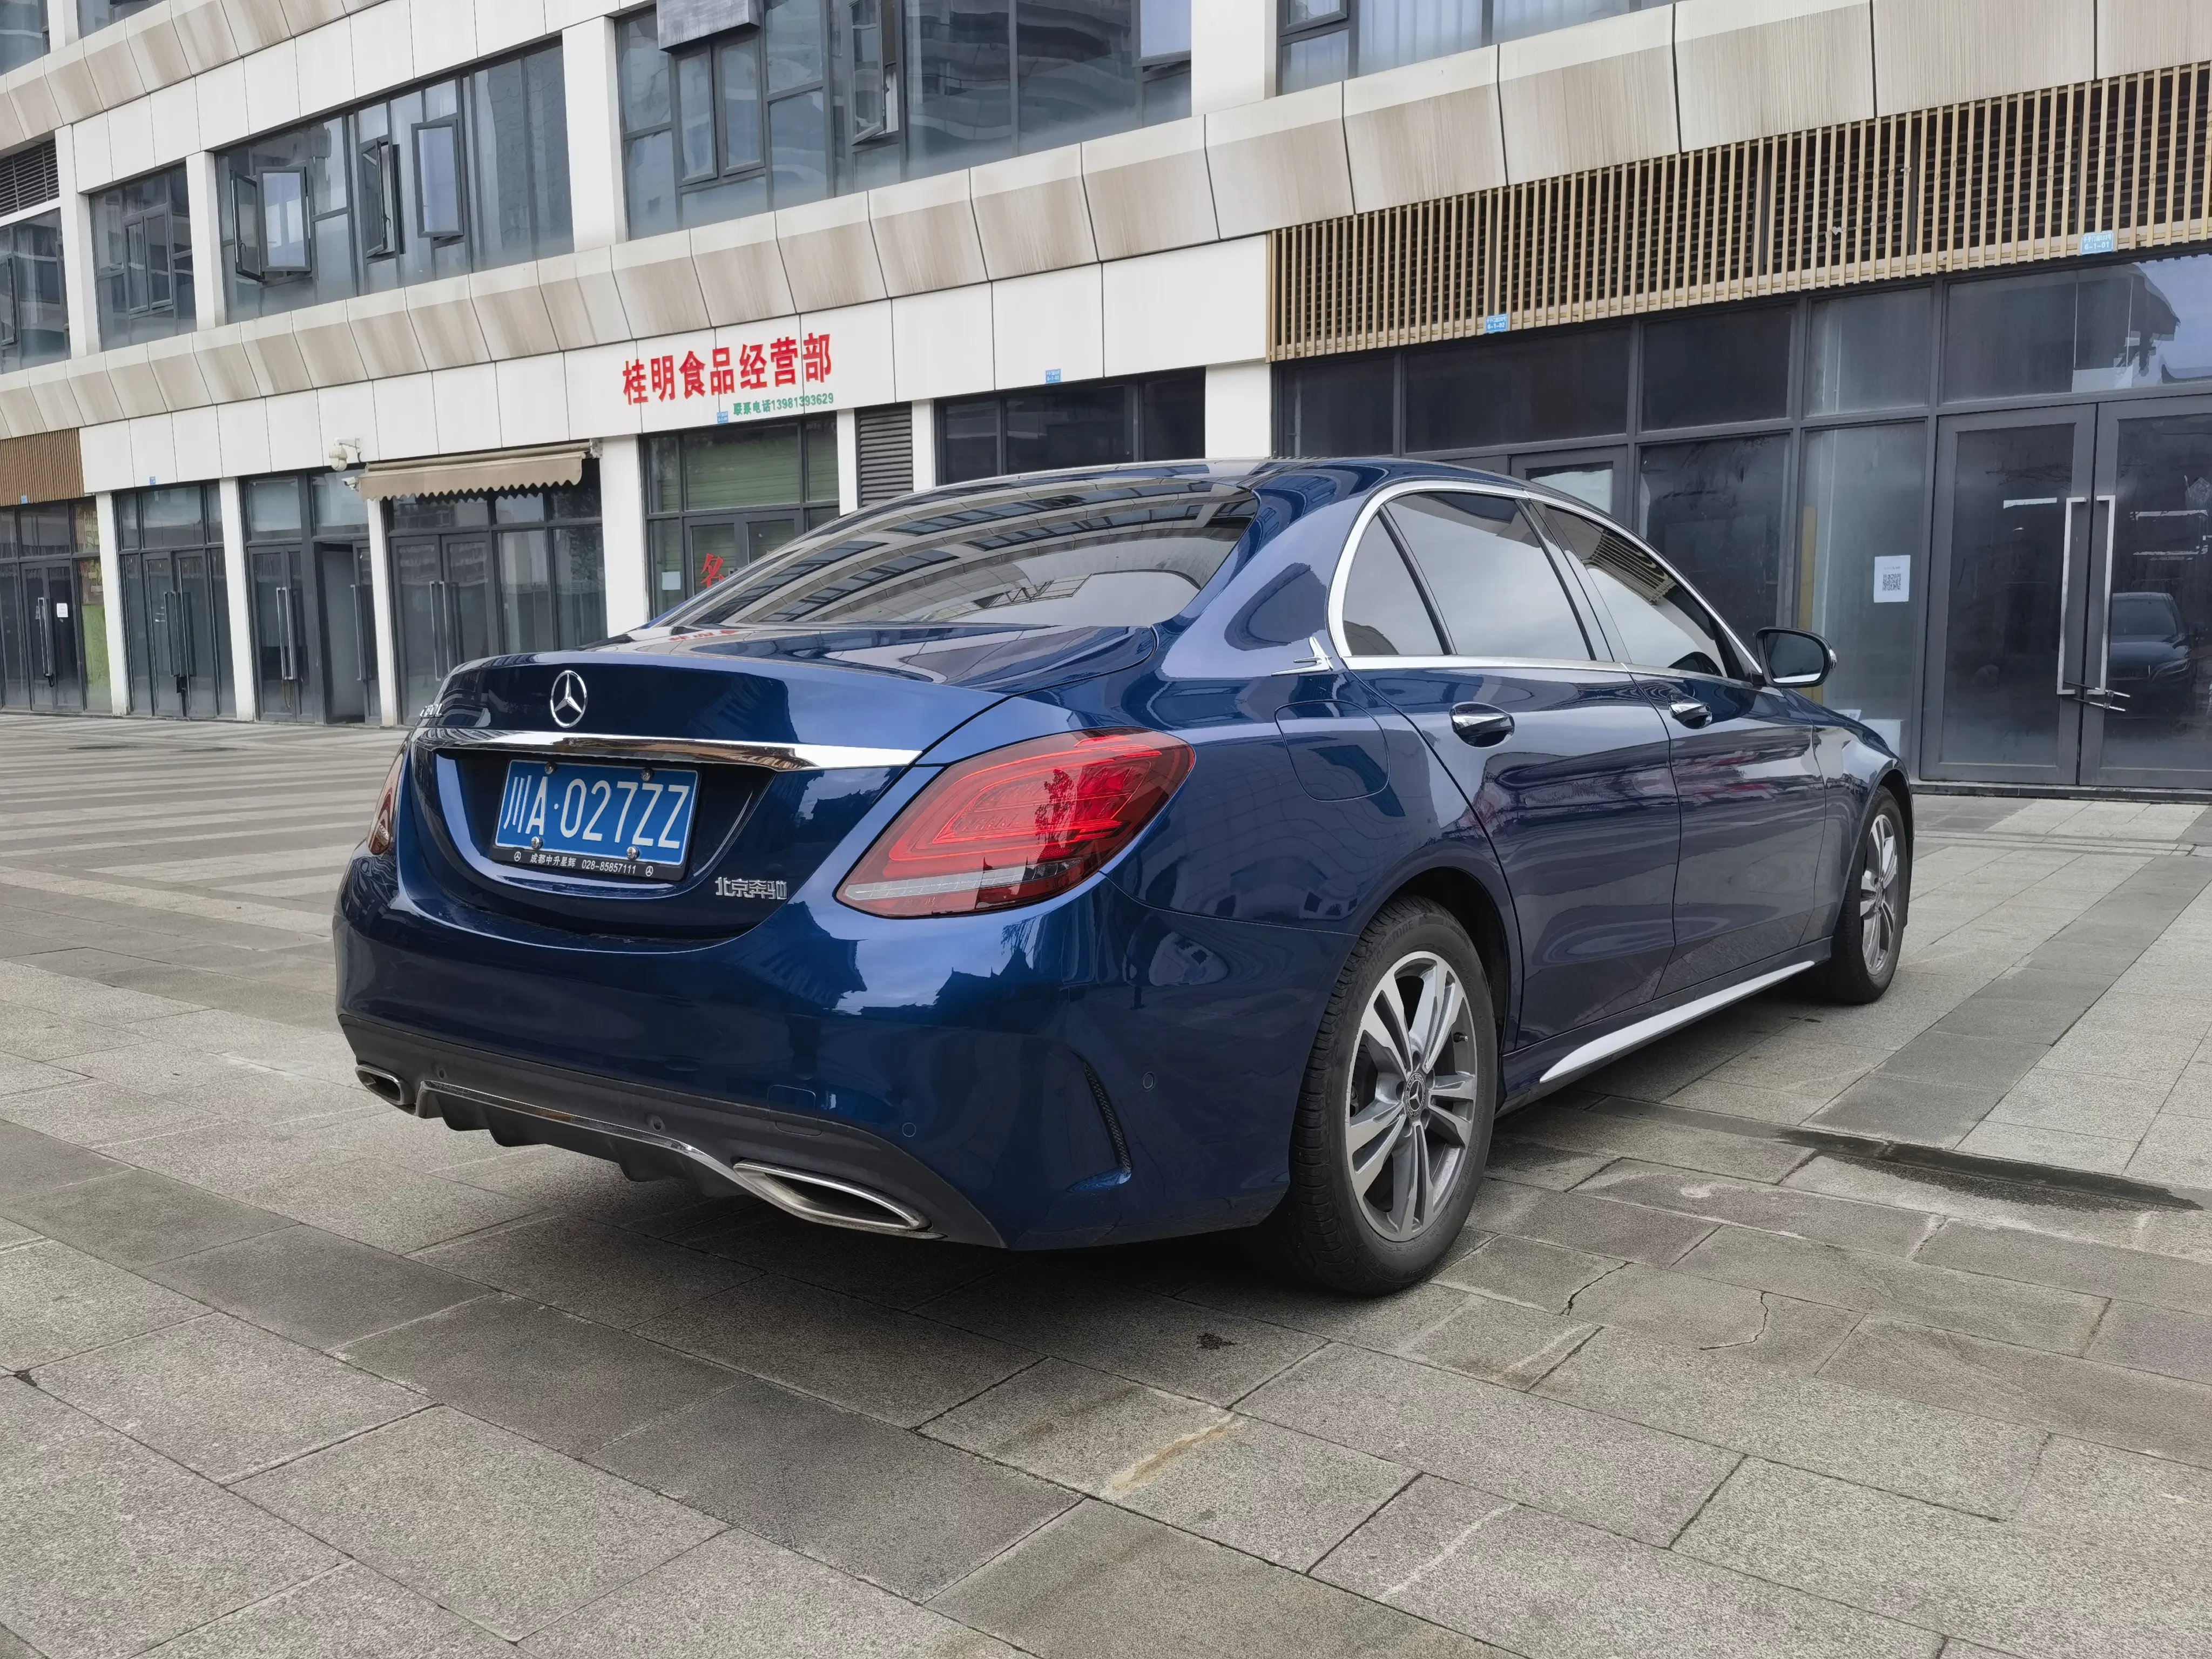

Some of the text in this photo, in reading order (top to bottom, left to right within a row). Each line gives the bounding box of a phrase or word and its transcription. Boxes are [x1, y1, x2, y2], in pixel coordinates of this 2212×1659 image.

[2084, 241, 2109, 250] 6-1-01
[622, 332, 832, 406] 桂明食品经营部
[529, 853, 636, 875] 成都中升星辉 028-85857111
[714, 876, 787, 900] 北京奔驰
